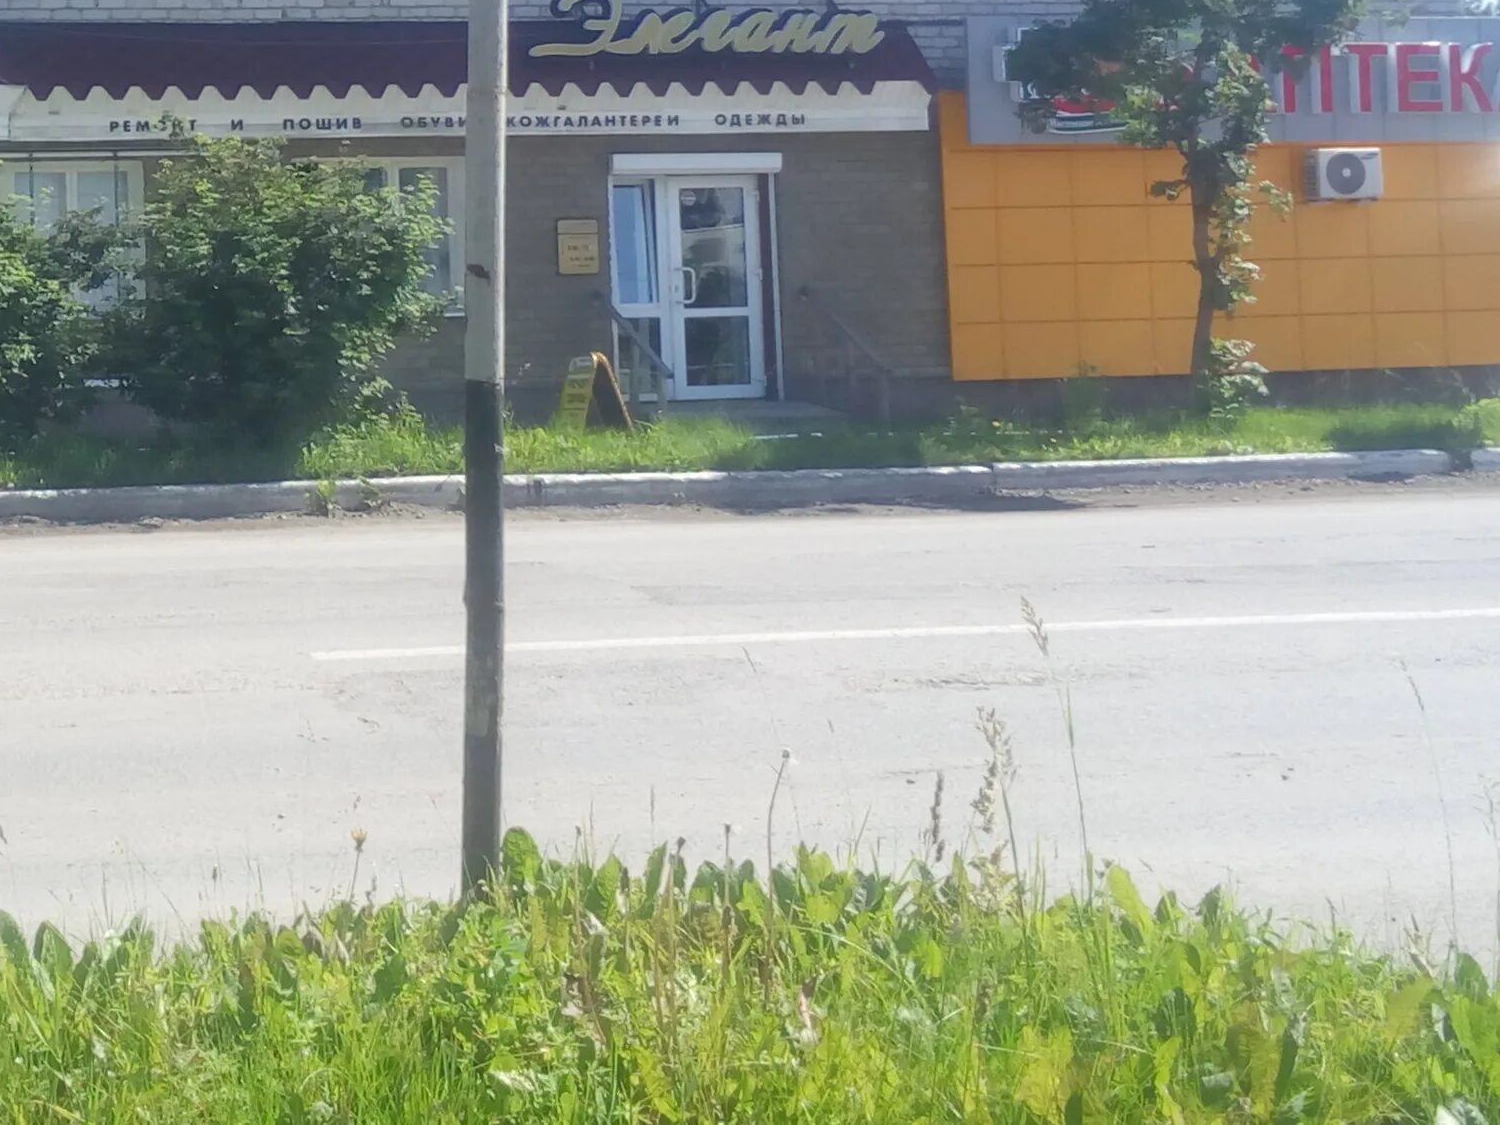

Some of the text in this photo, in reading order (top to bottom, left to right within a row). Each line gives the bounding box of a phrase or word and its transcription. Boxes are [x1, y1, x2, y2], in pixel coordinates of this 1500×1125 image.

[1230, 42, 1500, 114] ПТЕК
[231, 119, 243, 131] И
[283, 117, 363, 131] ПОШИВ
[506, 113, 680, 128] КОЖГАЛАНТЕРЕИ
[714, 113, 806, 127] ОДЕЖДЫ
